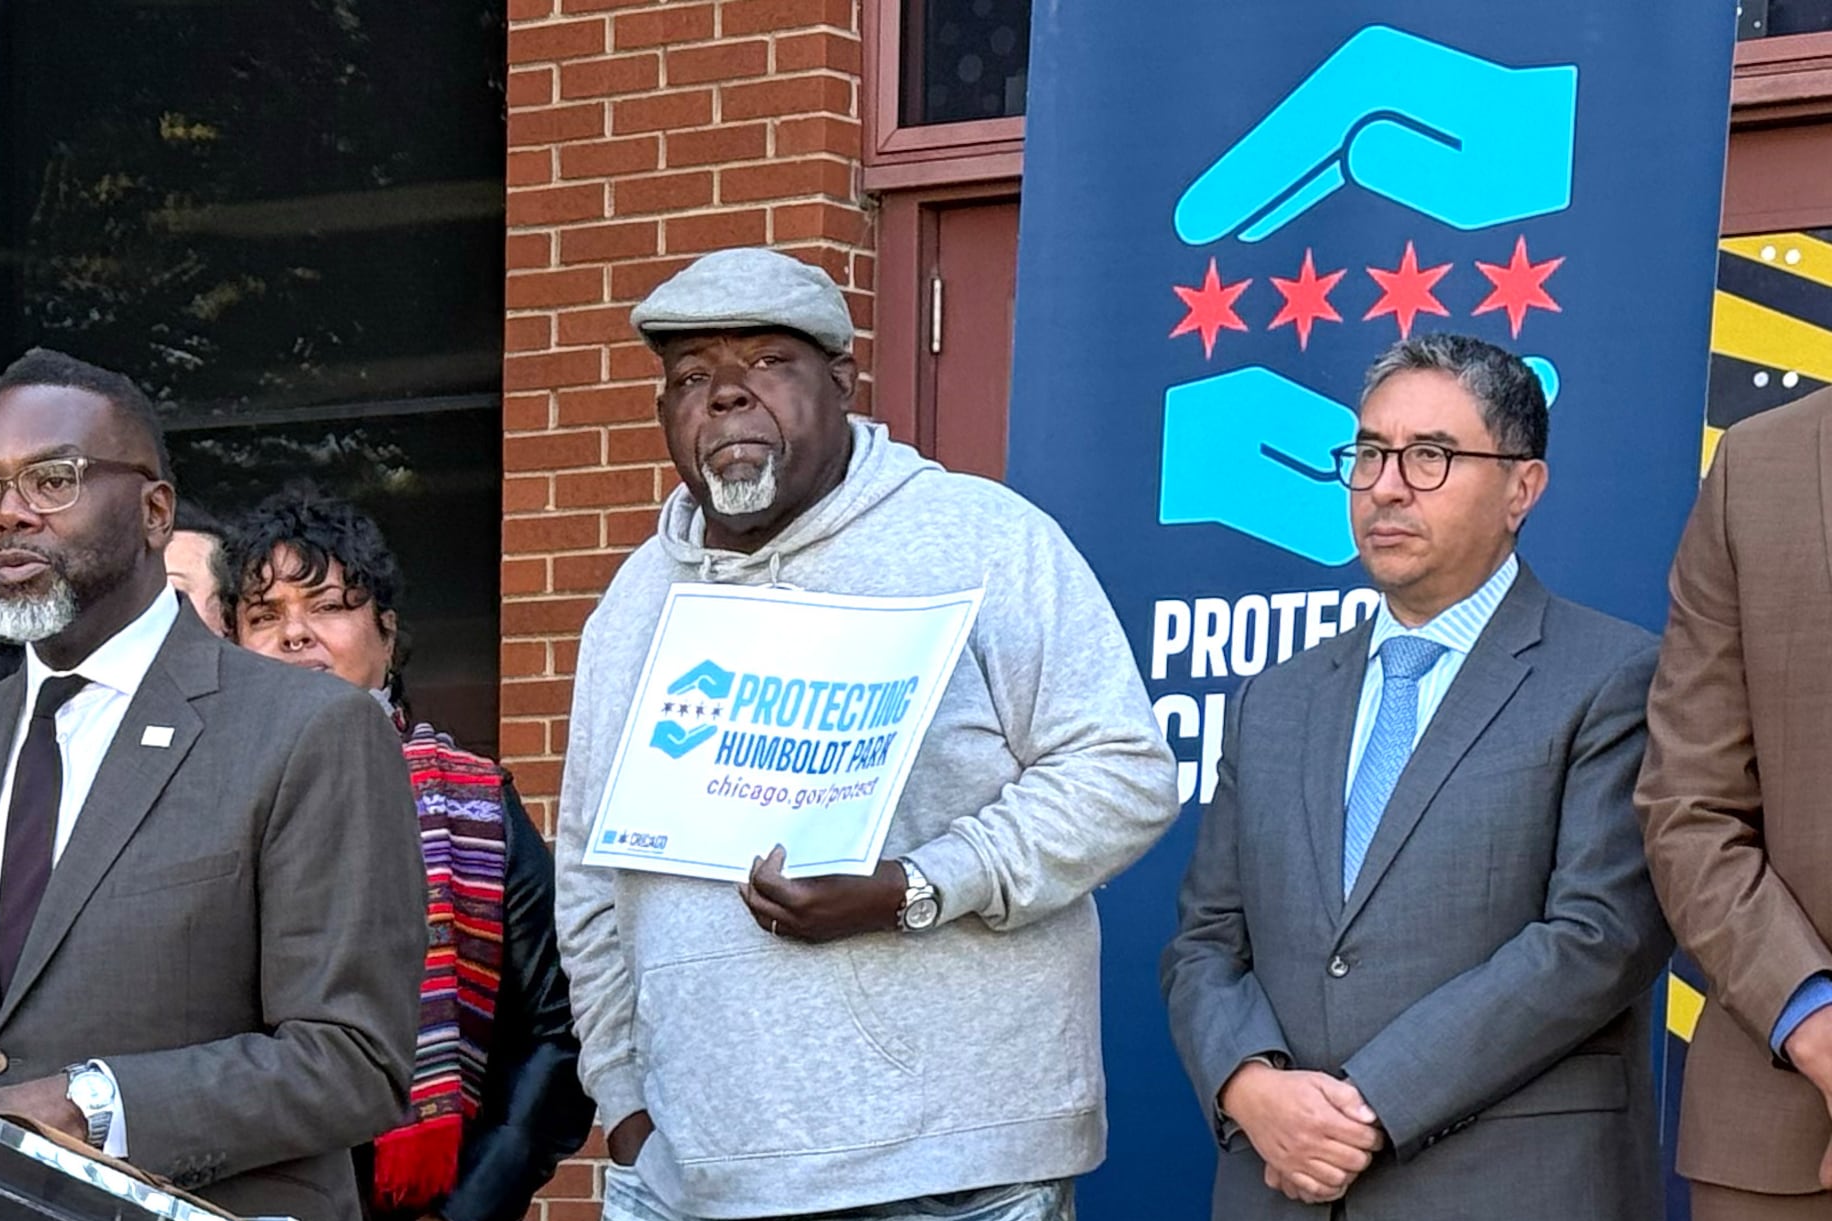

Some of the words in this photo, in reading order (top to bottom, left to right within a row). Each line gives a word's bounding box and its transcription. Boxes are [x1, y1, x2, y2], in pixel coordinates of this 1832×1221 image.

[729, 673, 919, 732] PROTECTING
[714, 730, 852, 774] HUMBOLDT
[845, 731, 898, 773] PARK
[707, 774, 879, 809] chicago.gov/protect
